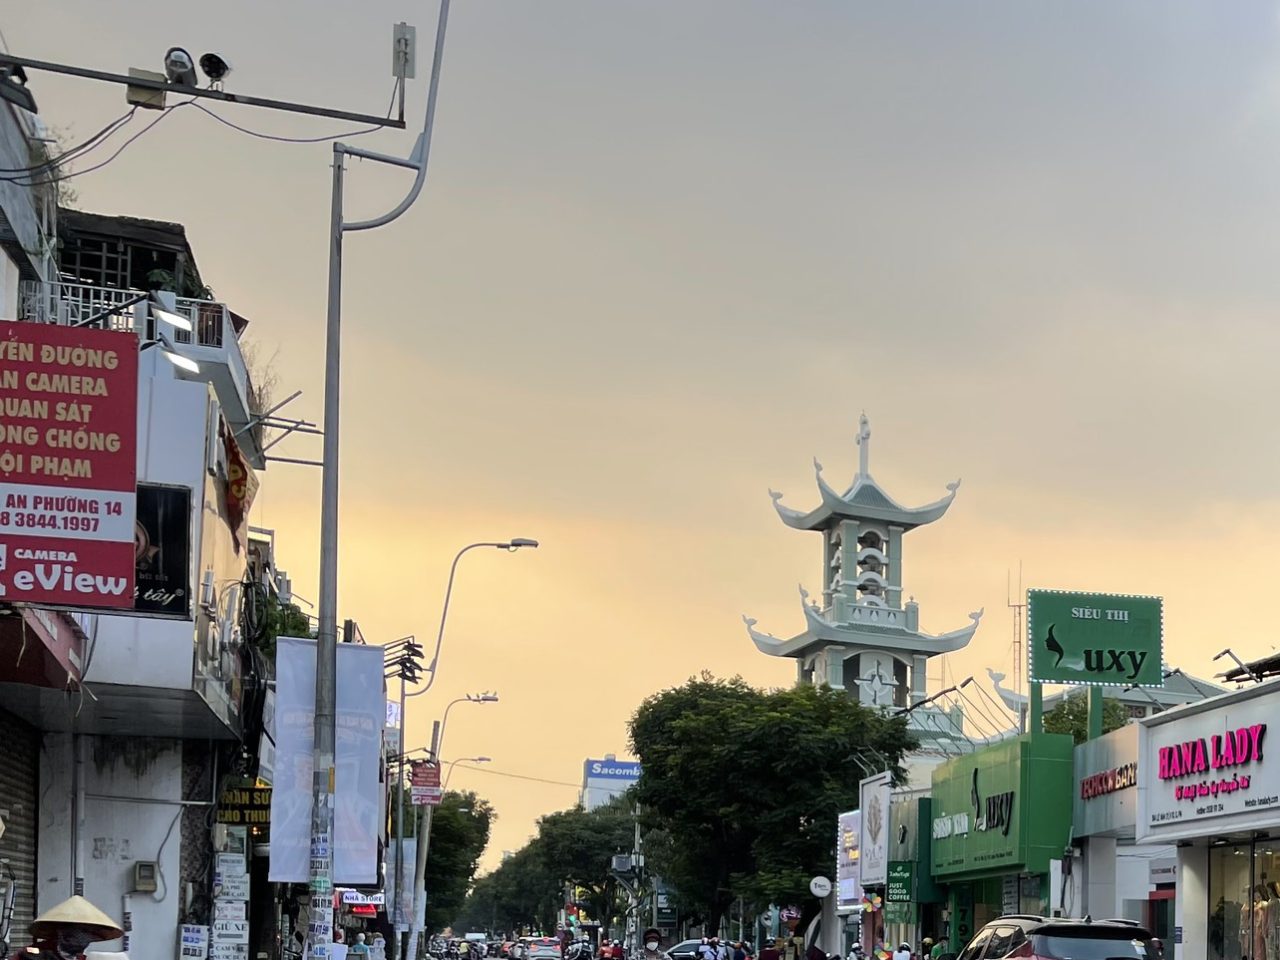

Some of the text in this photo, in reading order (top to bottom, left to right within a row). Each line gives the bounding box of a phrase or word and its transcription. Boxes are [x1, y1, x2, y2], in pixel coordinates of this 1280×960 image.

[40, 344, 119, 370] ĐƯỜNG
[25, 372, 109, 396] CAMERA
[55, 400, 93, 423] SÁT
[45, 425, 121, 453] CHỐNG
[30, 455, 92, 481] PHẠM
[5, 494, 122, 516] AN PHƯỜNG 14
[15, 512, 100, 532] 3844.1997
[14, 548, 78, 562] CAMERA
[13, 564, 128, 596] eView
[1071, 606, 1129, 623] SIÊU THỊ
[1158, 724, 1267, 780] HANA LADY
[234, 923, 248, 932] XE
